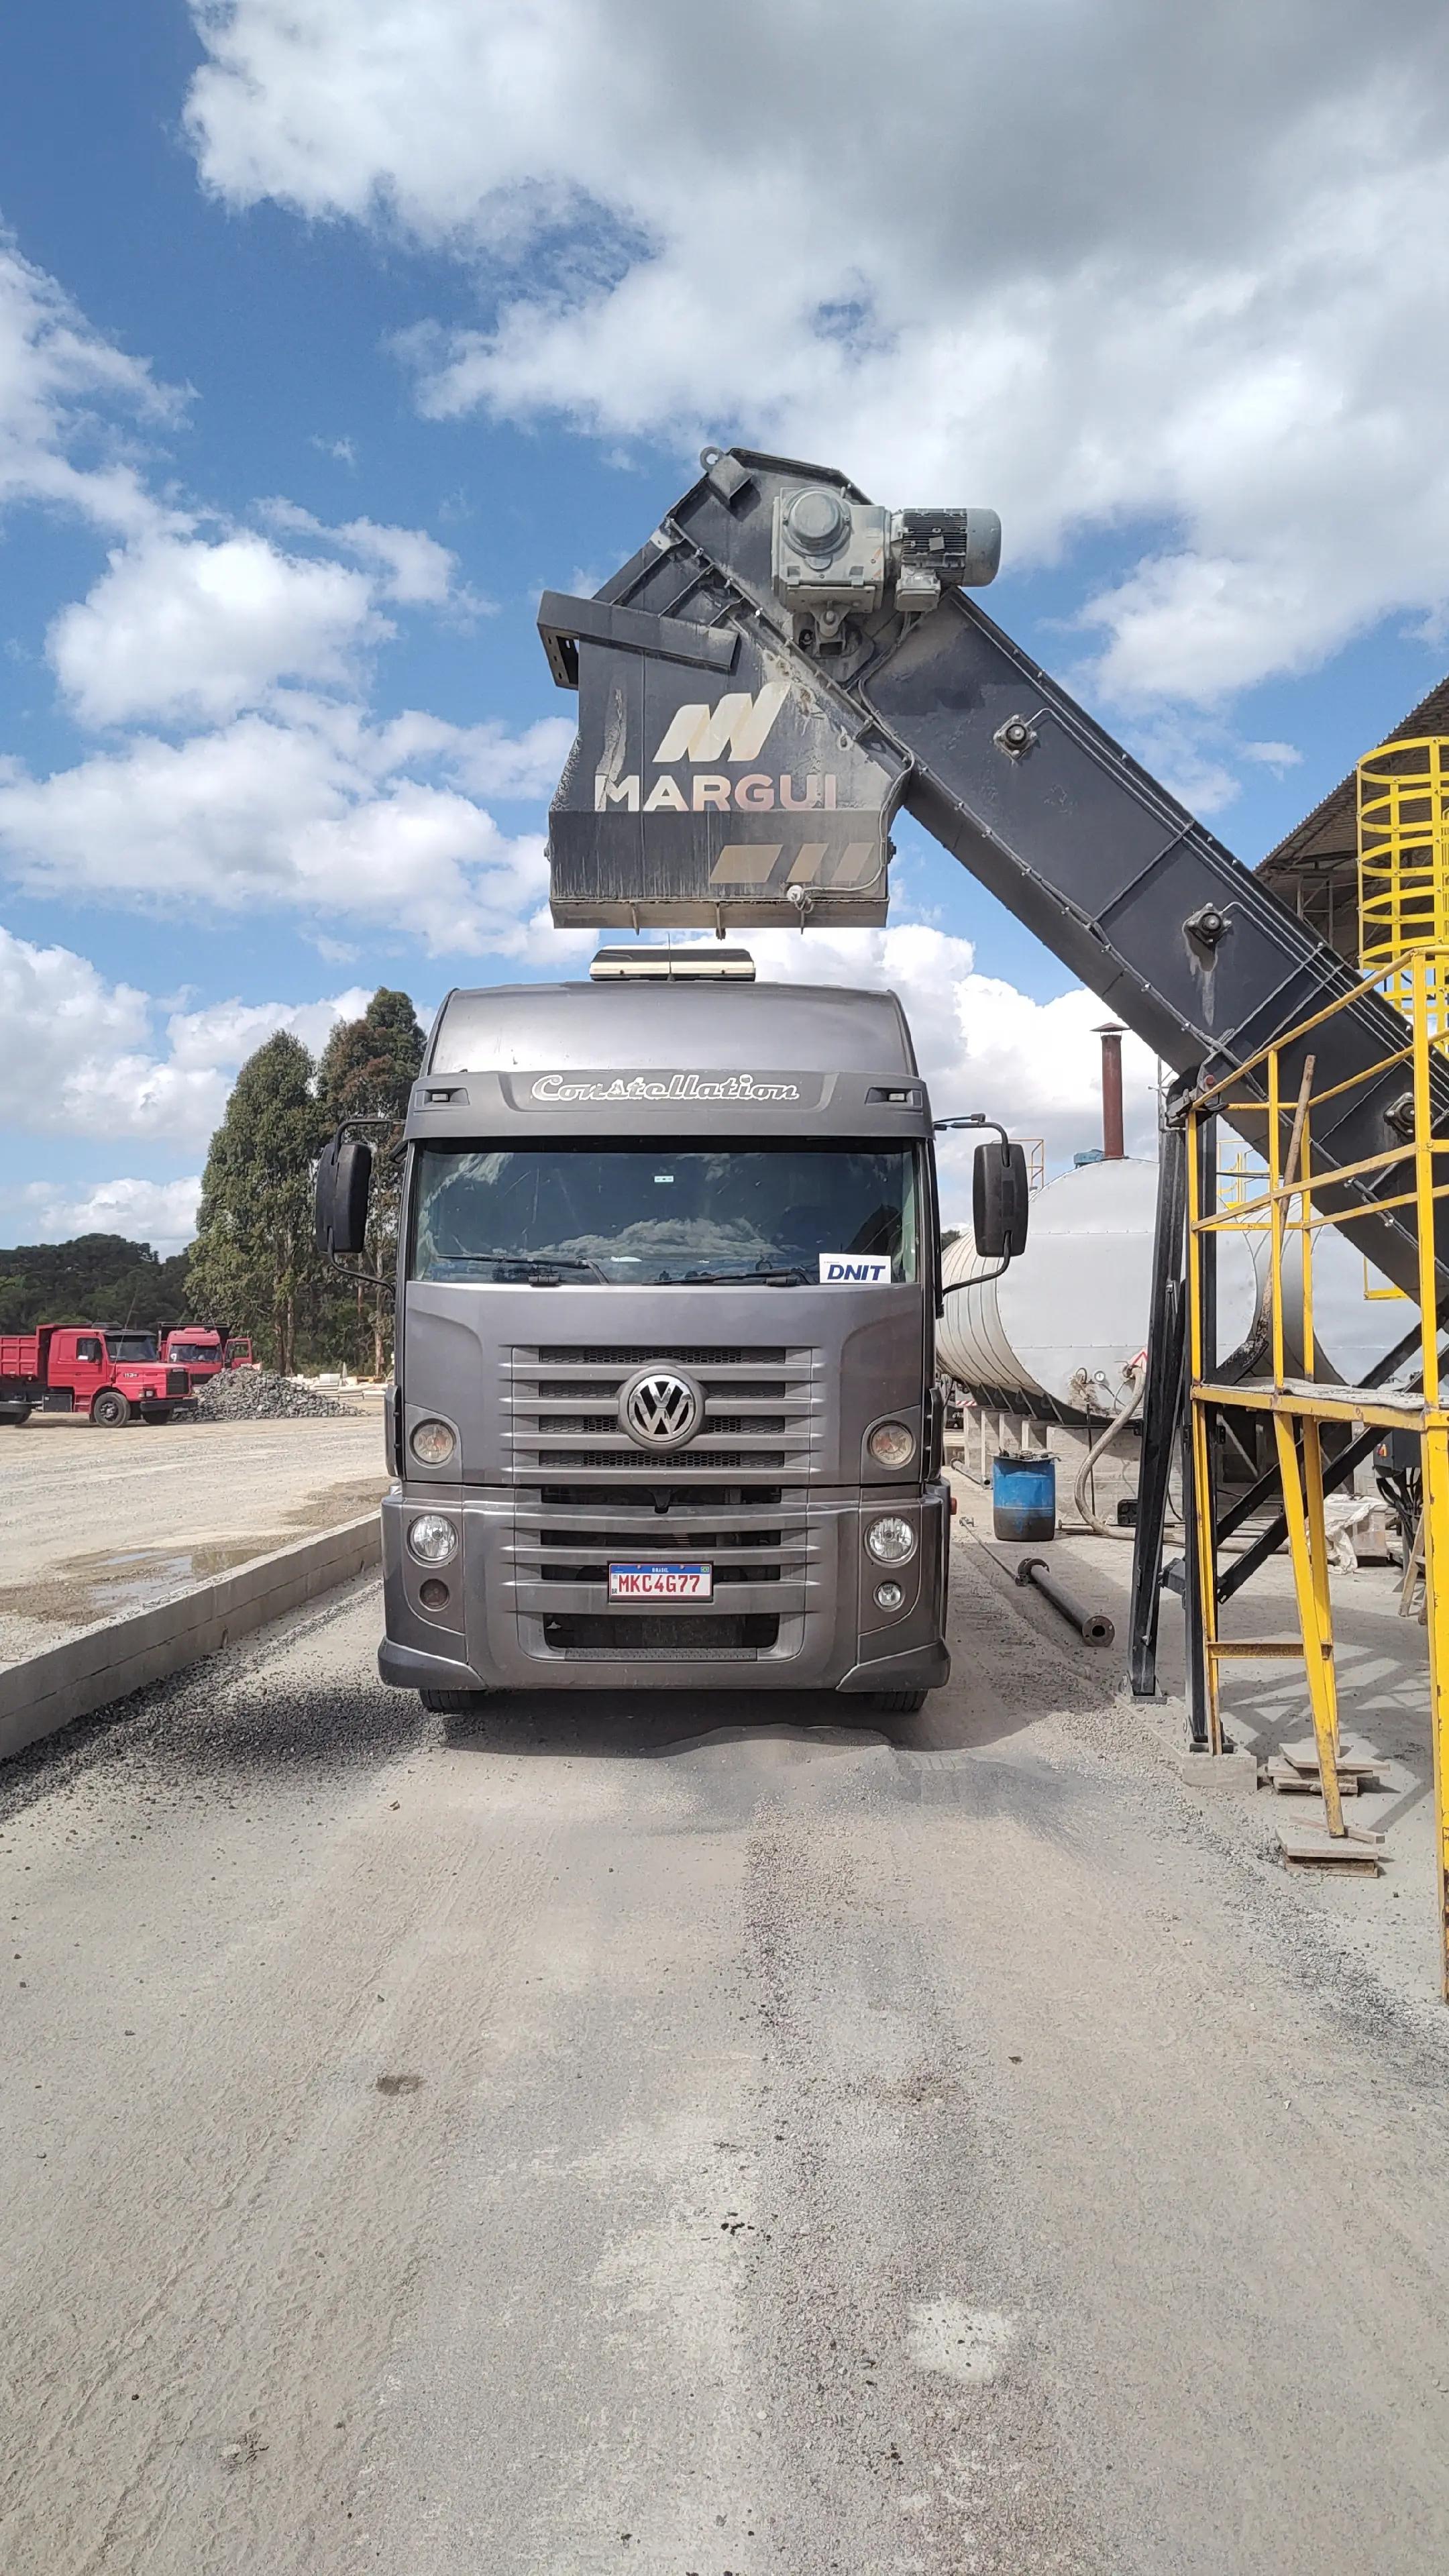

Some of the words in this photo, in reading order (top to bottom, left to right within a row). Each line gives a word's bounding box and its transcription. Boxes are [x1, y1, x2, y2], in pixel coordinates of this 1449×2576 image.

[594, 773, 838, 812] MARGUI
[531, 1073, 800, 1102] Constellation
[827, 1265, 885, 1281] DNIT
[619, 1574, 700, 1593] MKC4G77
